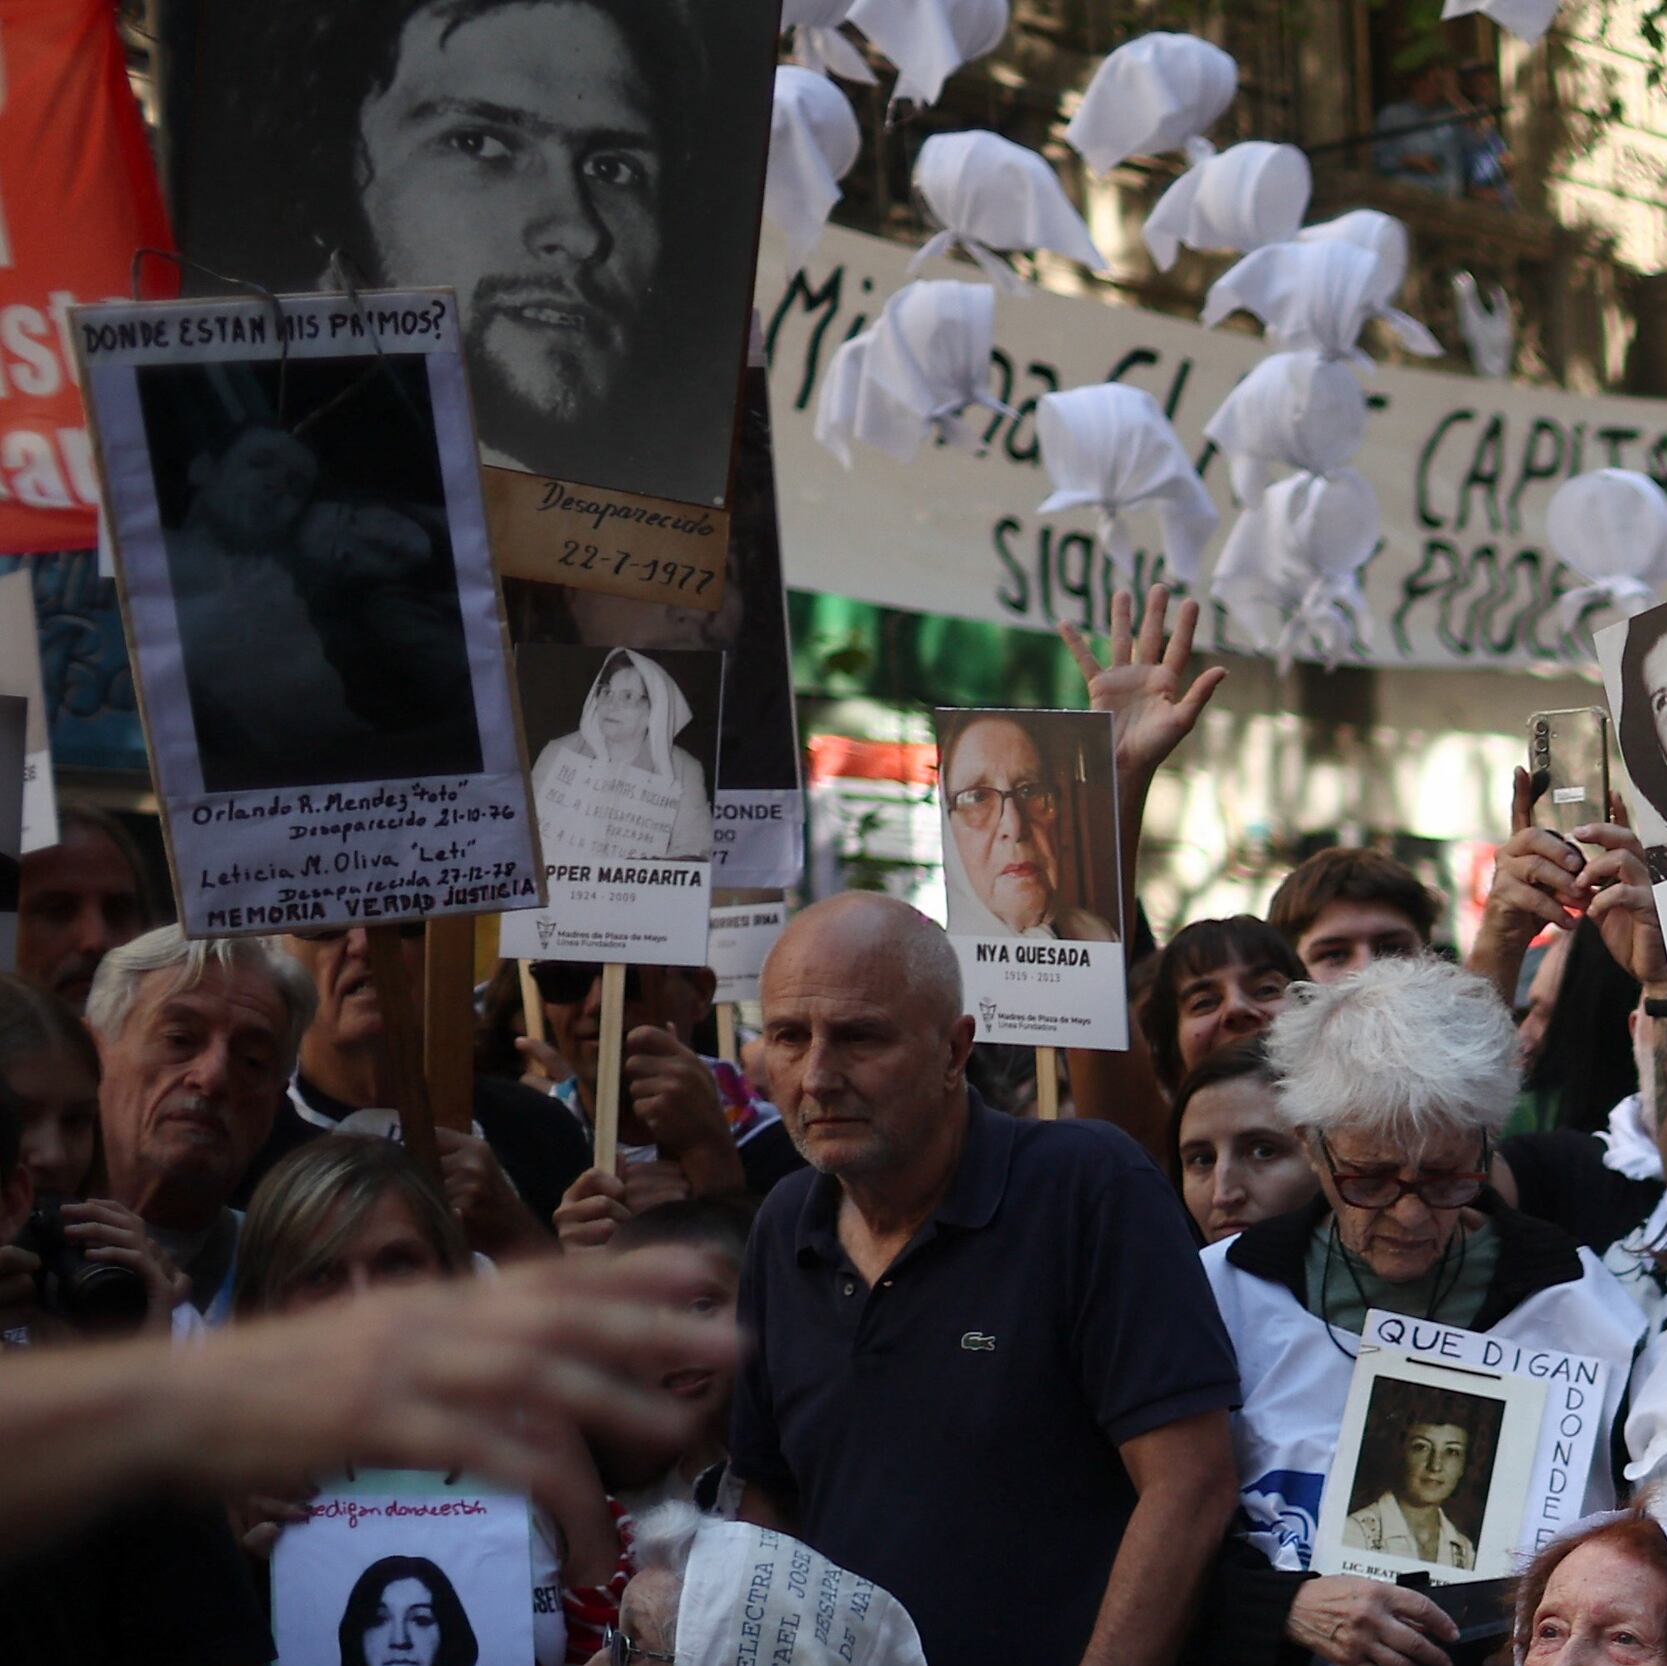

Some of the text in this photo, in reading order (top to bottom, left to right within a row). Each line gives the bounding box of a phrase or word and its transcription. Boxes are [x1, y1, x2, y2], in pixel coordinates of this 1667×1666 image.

[83, 319, 169, 353] DONDE
[179, 316, 266, 345] ESTAN
[536, 481, 715, 536] Desaparecido
[558, 539, 716, 595] 22-7-1977
[193, 796, 293, 825] Orlando
[300, 794, 321, 815] R.
[324, 788, 408, 812] Mendez
[289, 814, 426, 843] Desaparecido
[433, 805, 515, 828] 21-10-76
[202, 861, 294, 889] Leticia
[334, 849, 399, 870] Oliva
[278, 860, 518, 903] Desaparecida 27-12-78
[545, 864, 703, 888] PPER MARGARITA
[208, 900, 326, 928] MEMORIA
[345, 890, 436, 916] VERDAD
[976, 943, 1091, 968] NYA QUESADA
[1377, 1318, 1600, 1387] QUE DIGAN
[1366, 1565, 1400, 1581] BEAT
[813, 1557, 845, 1646] DESAPA
